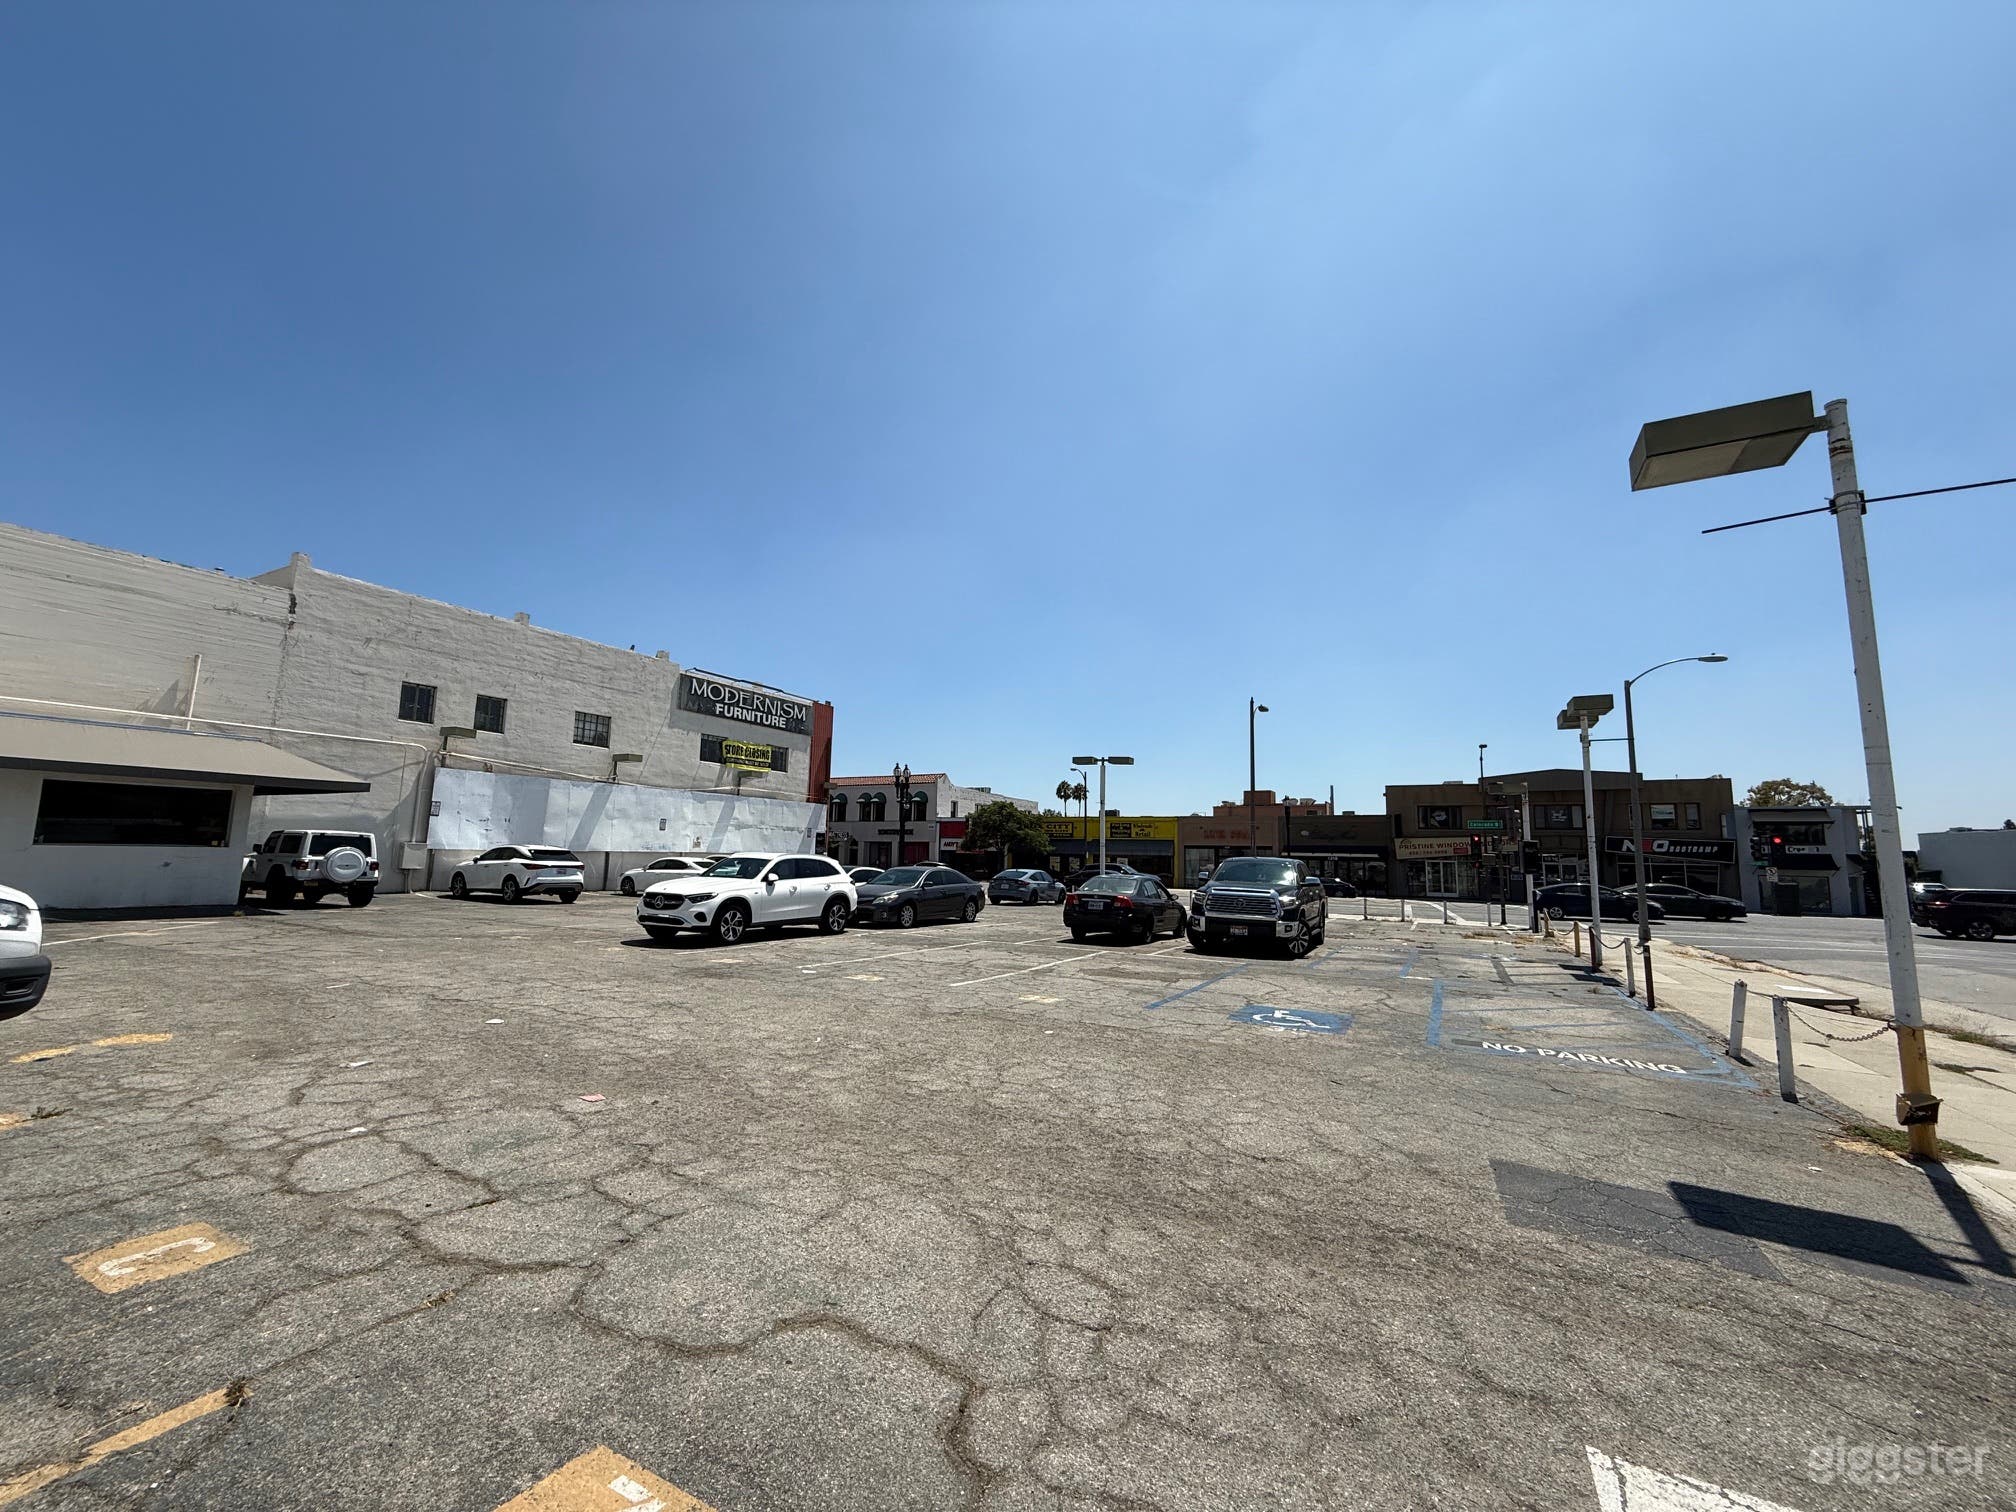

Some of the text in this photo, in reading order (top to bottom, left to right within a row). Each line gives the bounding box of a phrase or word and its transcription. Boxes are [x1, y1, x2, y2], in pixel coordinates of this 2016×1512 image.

[691, 678, 806, 721] MODERNISM
[715, 702, 787, 728] FURNITURE
[724, 744, 770, 761] STORE CLOSING
[1399, 842, 1435, 850] PRISTINE
[1436, 841, 1471, 849] WINDOW
[1481, 1041, 1688, 1074] NO PARKING
